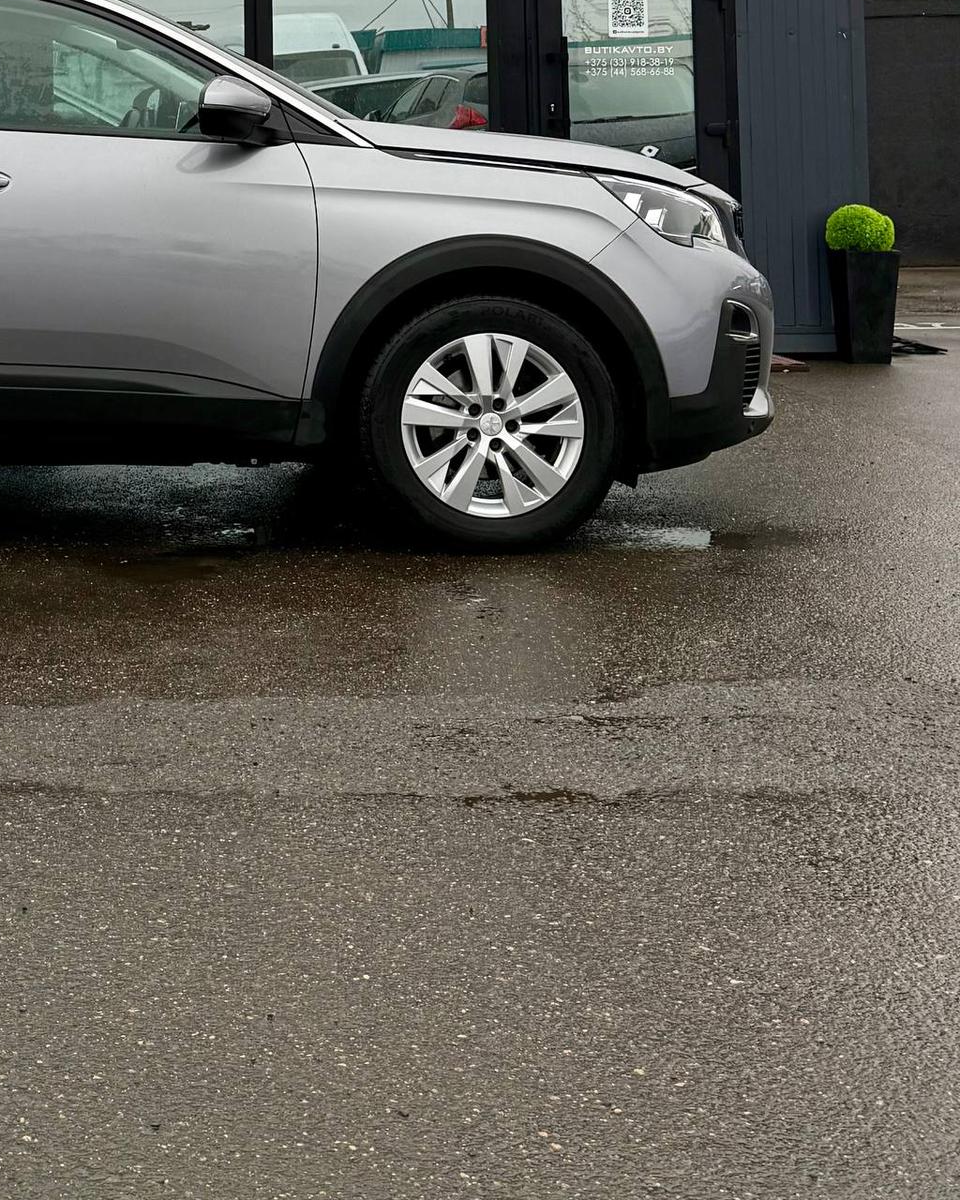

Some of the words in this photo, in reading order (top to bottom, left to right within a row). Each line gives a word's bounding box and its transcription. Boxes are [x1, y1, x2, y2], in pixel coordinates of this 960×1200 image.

[610, 58, 626, 69] (33)
[630, 58, 674, 66] 918-38-19
[585, 68, 607, 76] +375
[610, 68, 627, 78] (44)
